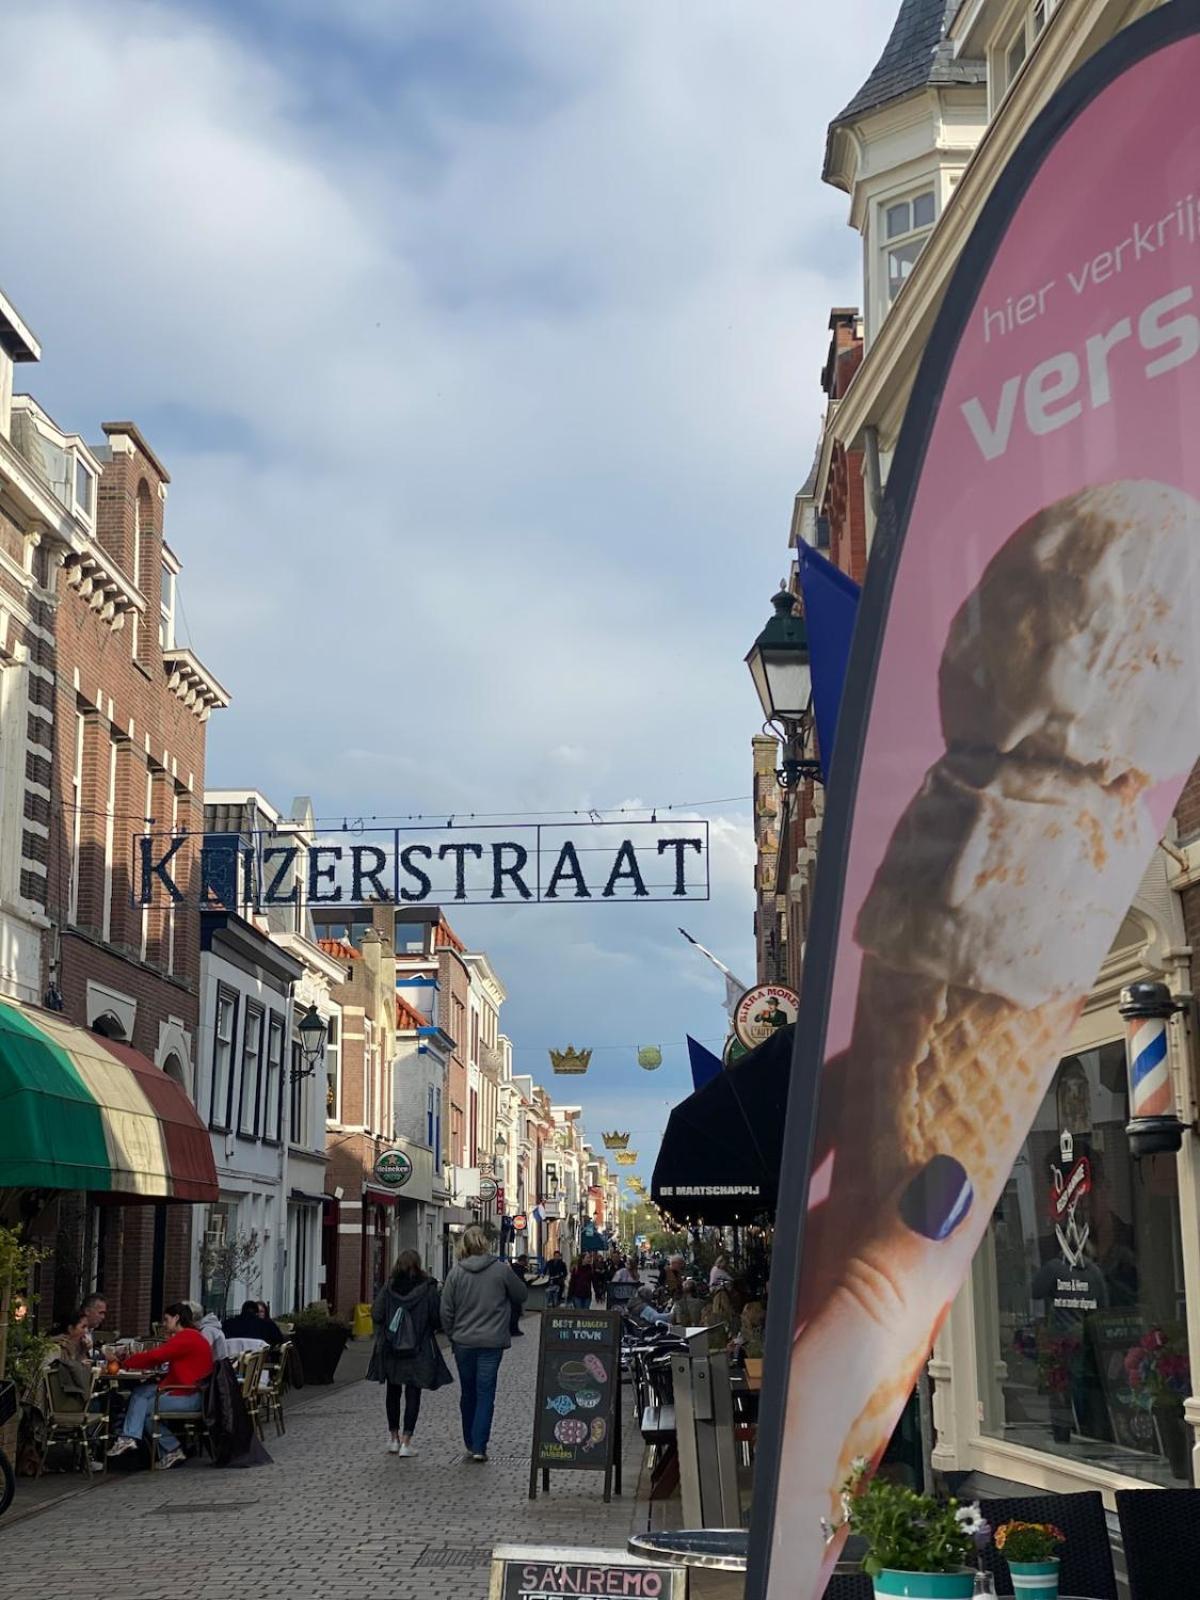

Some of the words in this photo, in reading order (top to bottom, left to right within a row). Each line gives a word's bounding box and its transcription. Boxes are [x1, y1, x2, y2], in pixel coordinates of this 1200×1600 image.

[982, 281, 1055, 343] hier
[1067, 194, 1200, 295] verkrij
[960, 285, 1200, 461] vers
[740, 991, 766, 1024] BIRRA
[768, 988, 799, 1011] MORE
[376, 1164, 408, 1173] Heineken
[659, 1186, 674, 1196] DE
[676, 1185, 760, 1196] MAATSCHAPPIJ
[552, 1319, 573, 1329] BEST
[573, 1330, 601, 1340] TOWN
